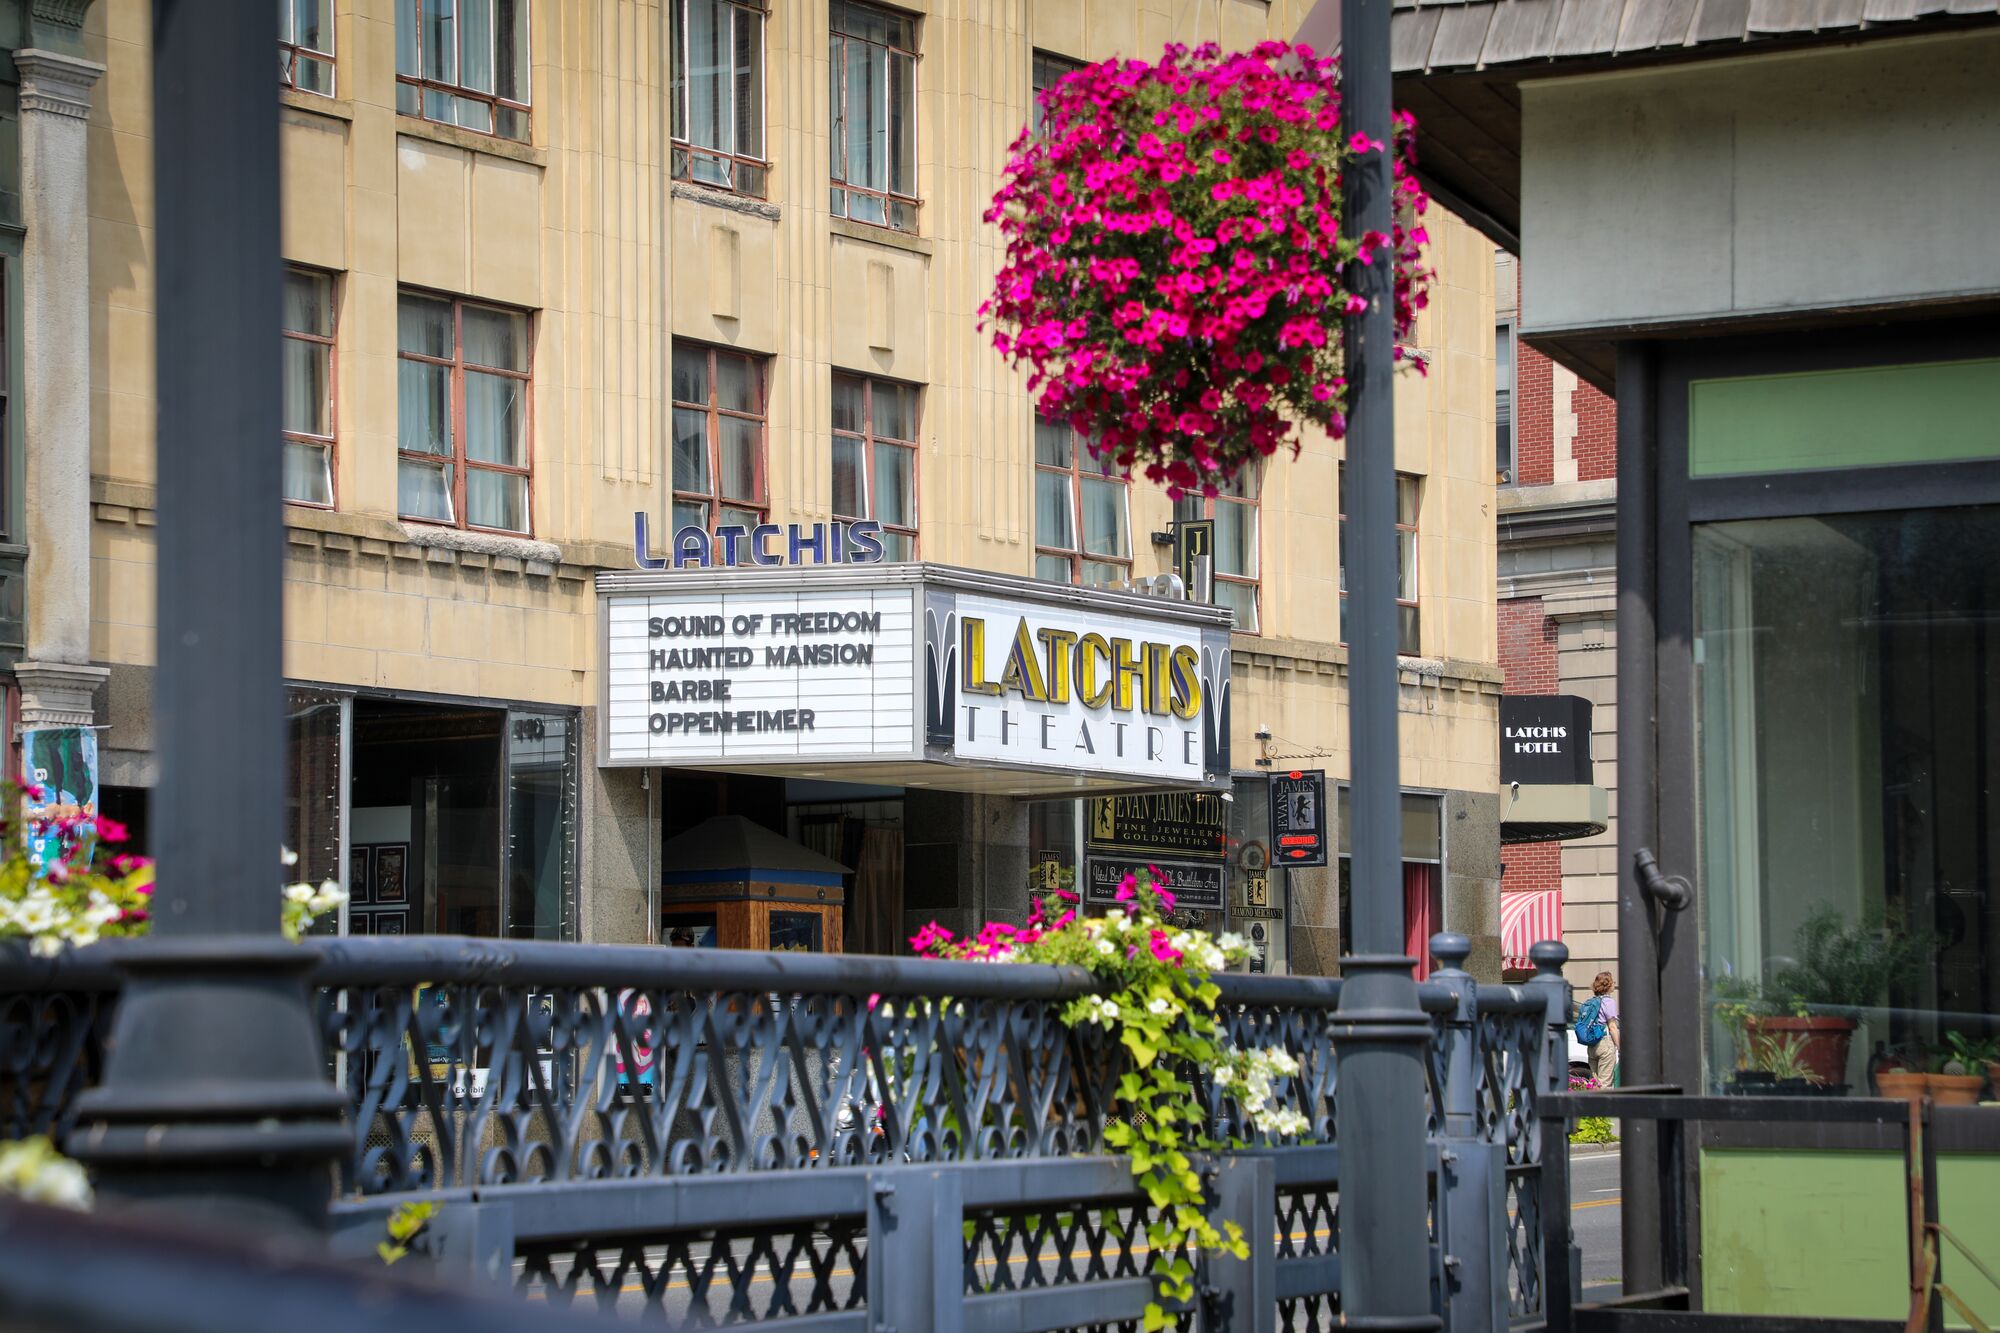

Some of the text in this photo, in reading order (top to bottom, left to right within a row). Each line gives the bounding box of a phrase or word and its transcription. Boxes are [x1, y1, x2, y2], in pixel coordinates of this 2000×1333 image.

[633, 511, 885, 570] LATCHIS
[649, 611, 881, 637] SOUND OF FREEDOM
[650, 644, 873, 669] HAUNTED MANSION
[961, 616, 1202, 720] LATCHIS
[651, 679, 731, 702] BARBIE
[649, 709, 815, 733] OPPENHEIMER
[1505, 726, 1567, 738] LATCHIS
[961, 705, 1198, 765] THEATRE
[1514, 742, 1561, 753] HOTEL
[1280, 781, 1315, 794] JAMES
[1116, 792, 1222, 826] EVAN JAMES LTD.
[1278, 794, 1288, 827] EVAN
[1116, 823, 1221, 838] FINE JEWELERS
[1123, 832, 1208, 846] GOLDSMITHS
[455, 1086, 485, 1094] Exibit
